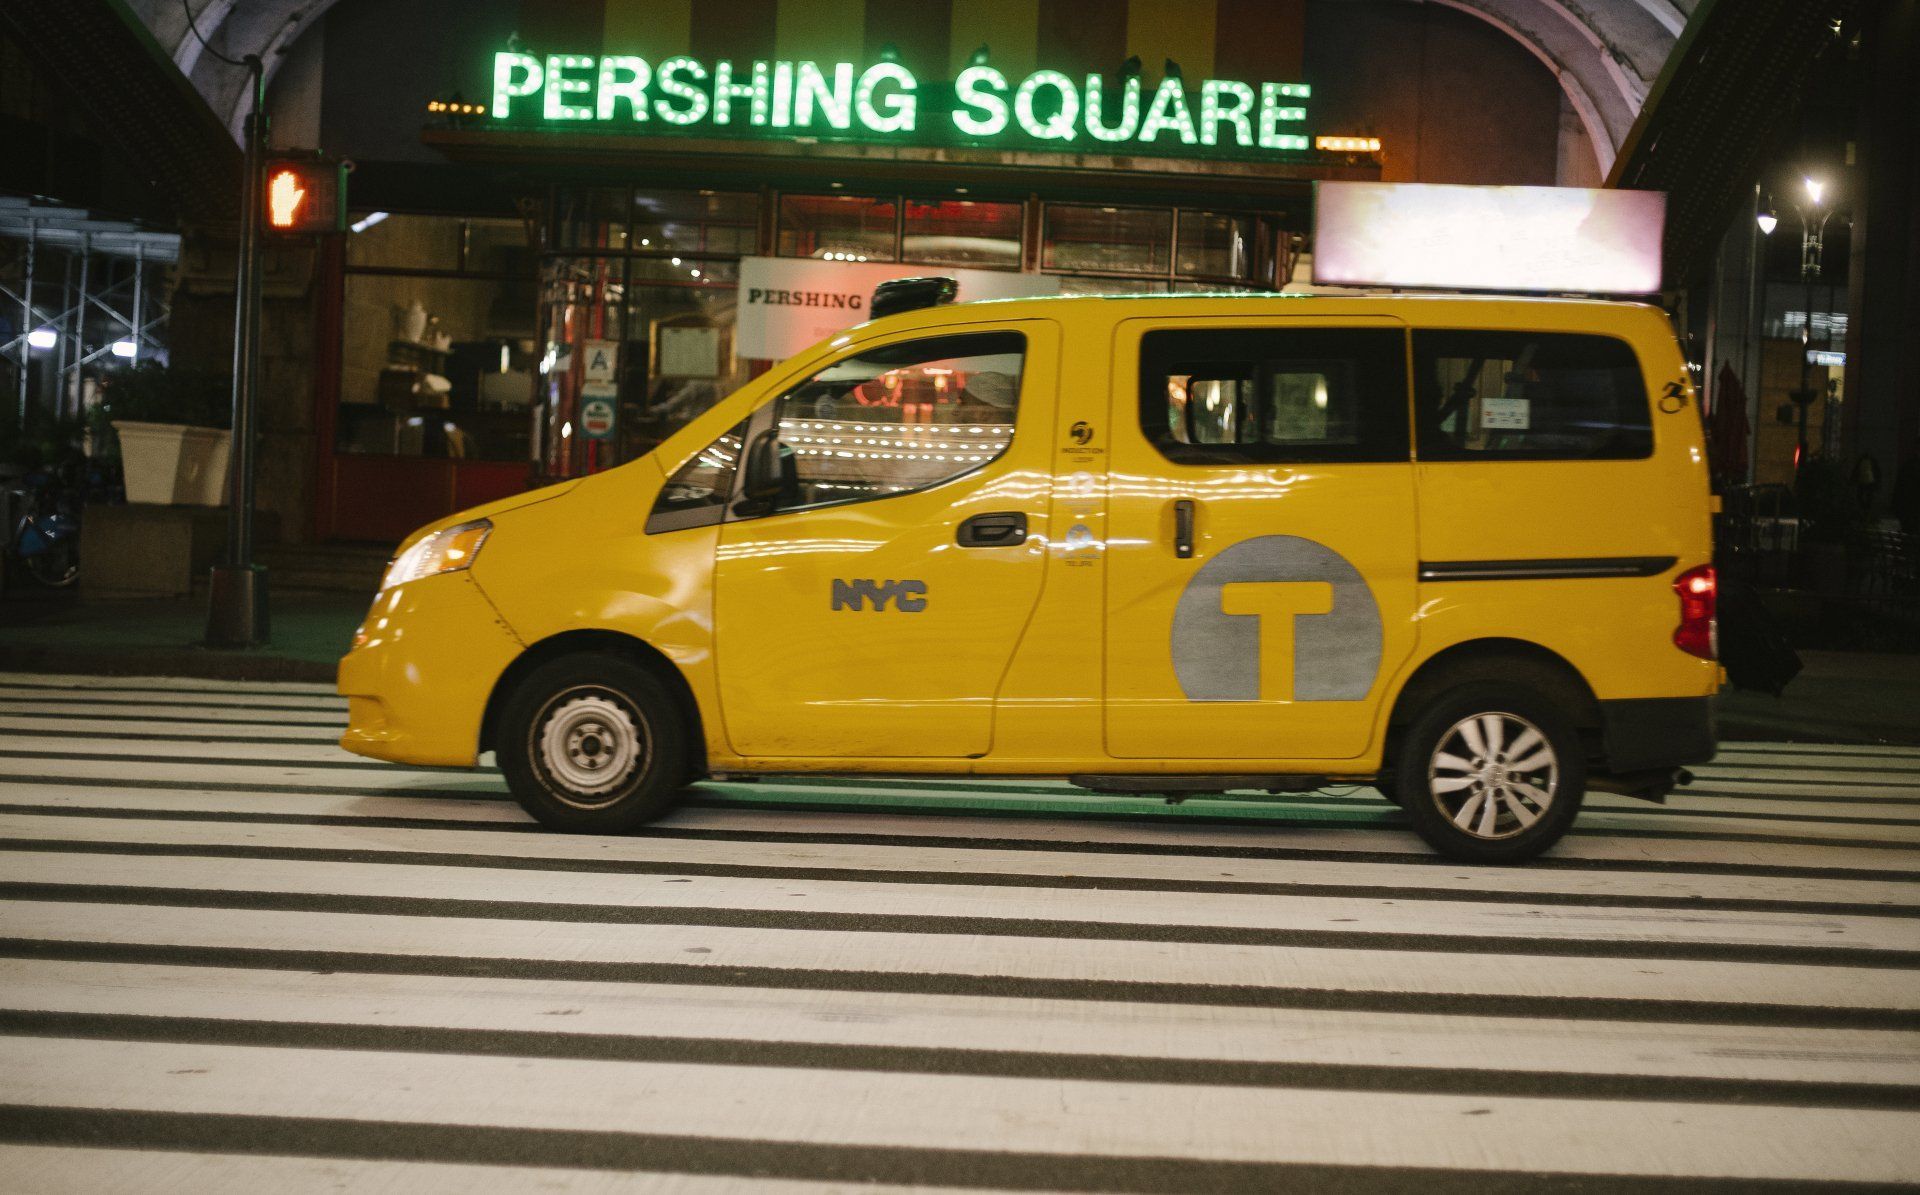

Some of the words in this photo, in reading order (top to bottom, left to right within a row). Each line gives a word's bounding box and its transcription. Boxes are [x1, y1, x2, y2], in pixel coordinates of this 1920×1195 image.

[492, 52, 918, 133] PERSHING
[951, 65, 1311, 150] SQUARE
[748, 287, 863, 310] PERSHING
[590, 349, 609, 370] A
[832, 578, 928, 612] NYC
[1221, 581, 1334, 701] T
